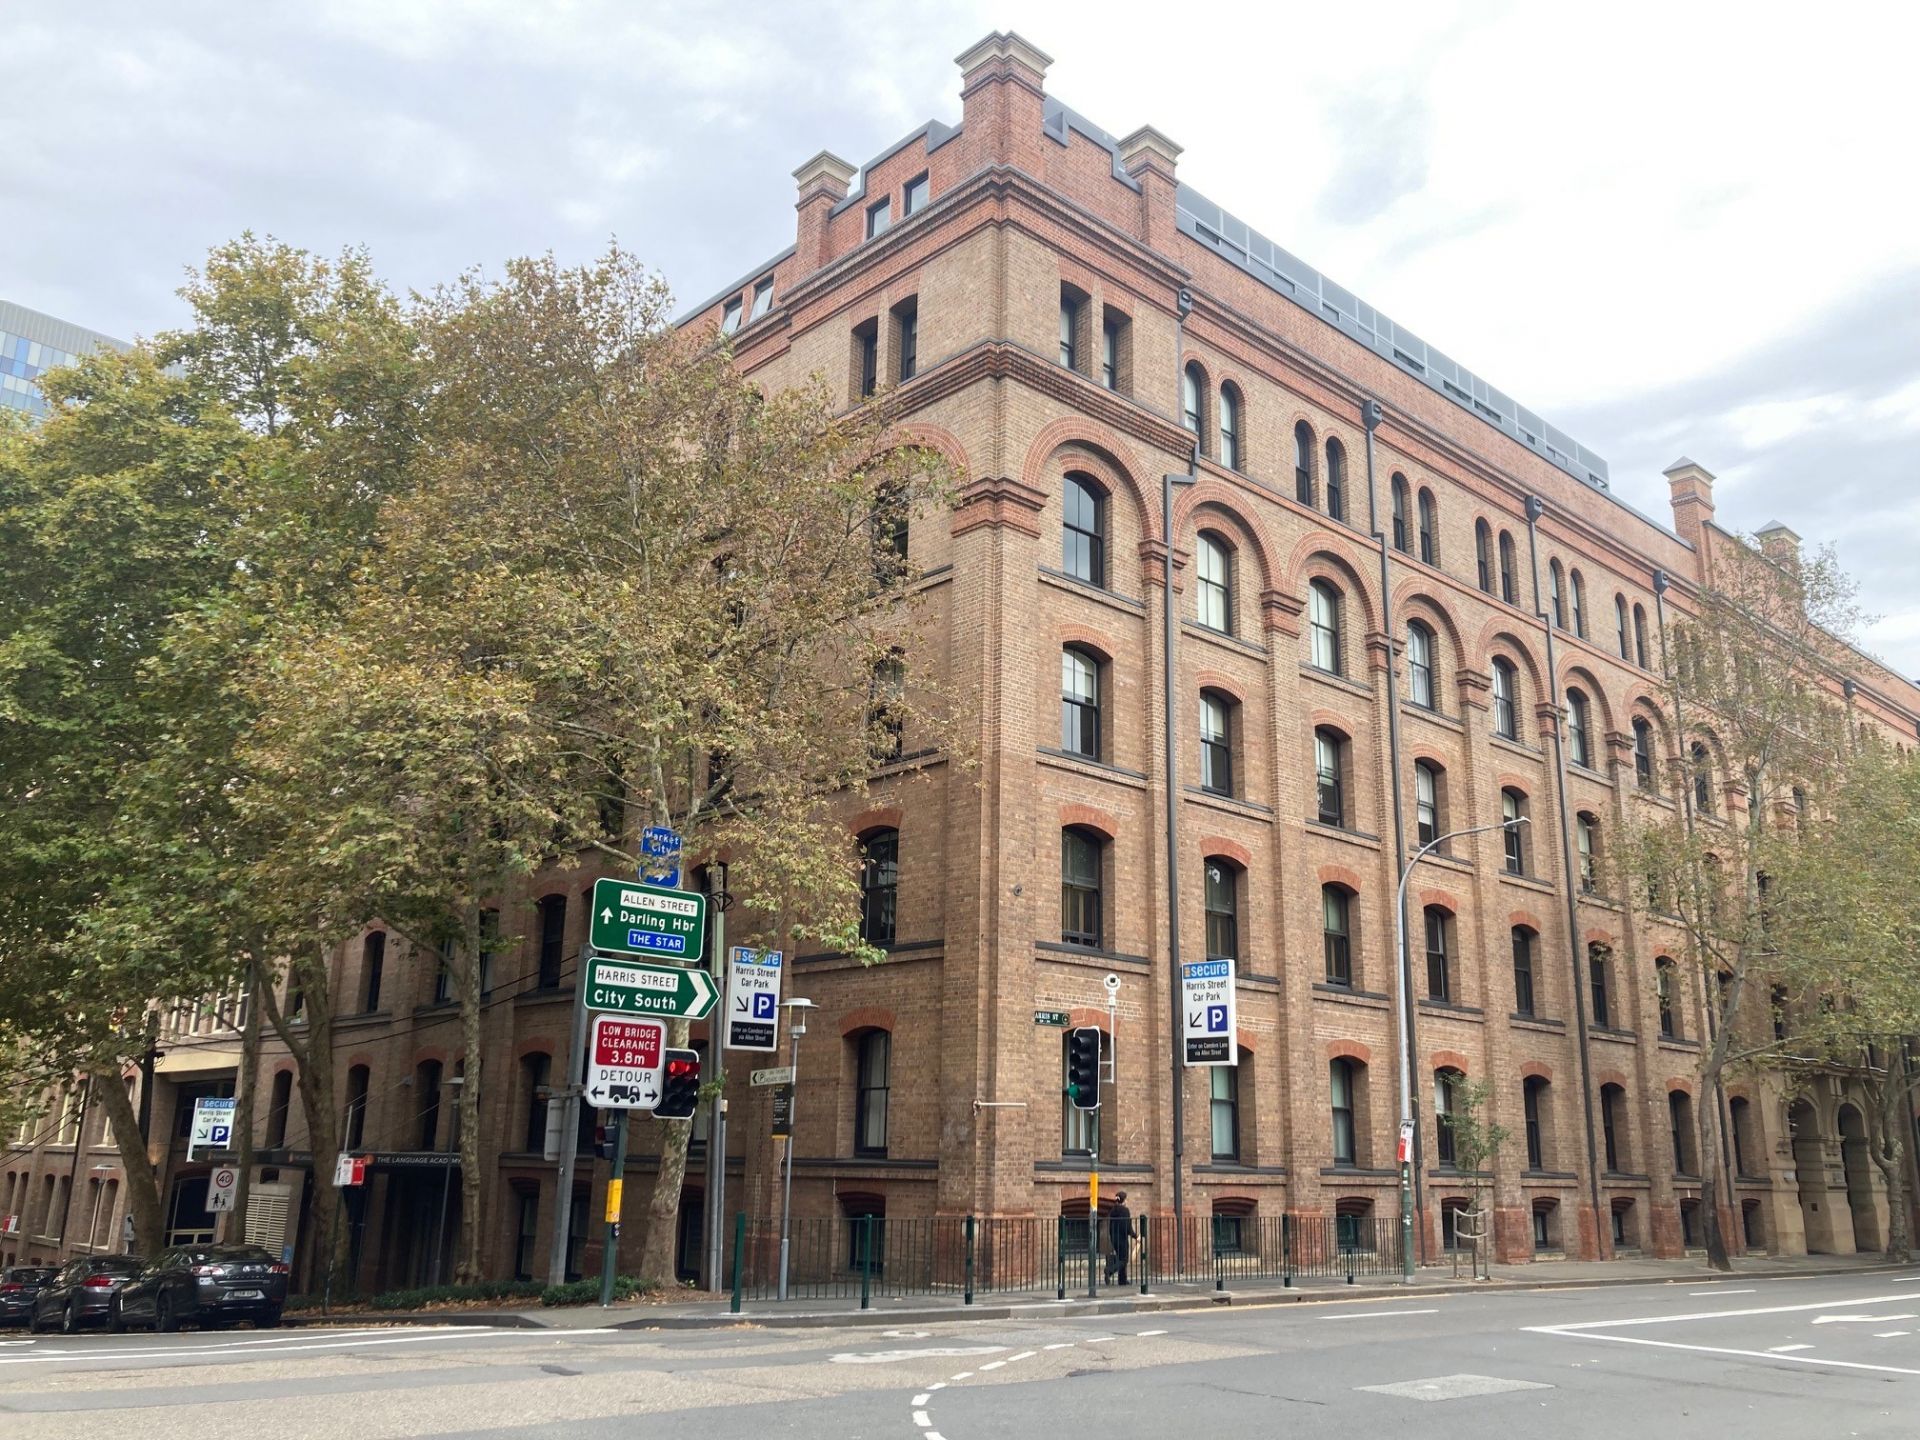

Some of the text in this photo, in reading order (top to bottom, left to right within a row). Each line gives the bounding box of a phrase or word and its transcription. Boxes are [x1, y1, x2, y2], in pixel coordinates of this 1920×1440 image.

[646, 830, 679, 845] Market
[623, 894, 695, 913] ALLEN STREET
[620, 910, 695, 932] Darling Hbr
[632, 933, 682, 949] THE STAR
[735, 966, 777, 978] Harris Street
[1191, 963, 1228, 977] secure
[597, 969, 677, 988] HARRIS STREET
[741, 978, 769, 988] Car Park
[1186, 980, 1227, 990] Harris Street
[594, 989, 676, 1010] City South
[1193, 992, 1221, 1002] Car Park
[758, 996, 770, 1015] P
[1212, 1009, 1223, 1029] P
[602, 1025, 657, 1039] LOW BRIDGE
[602, 1037, 656, 1051] CLEARANCE
[610, 1050, 645, 1065] 3.8m
[600, 1069, 652, 1083] DETOUR
[204, 1100, 234, 1108] secure
[214, 1128, 225, 1140] P
[219, 1175, 230, 1184] 40
